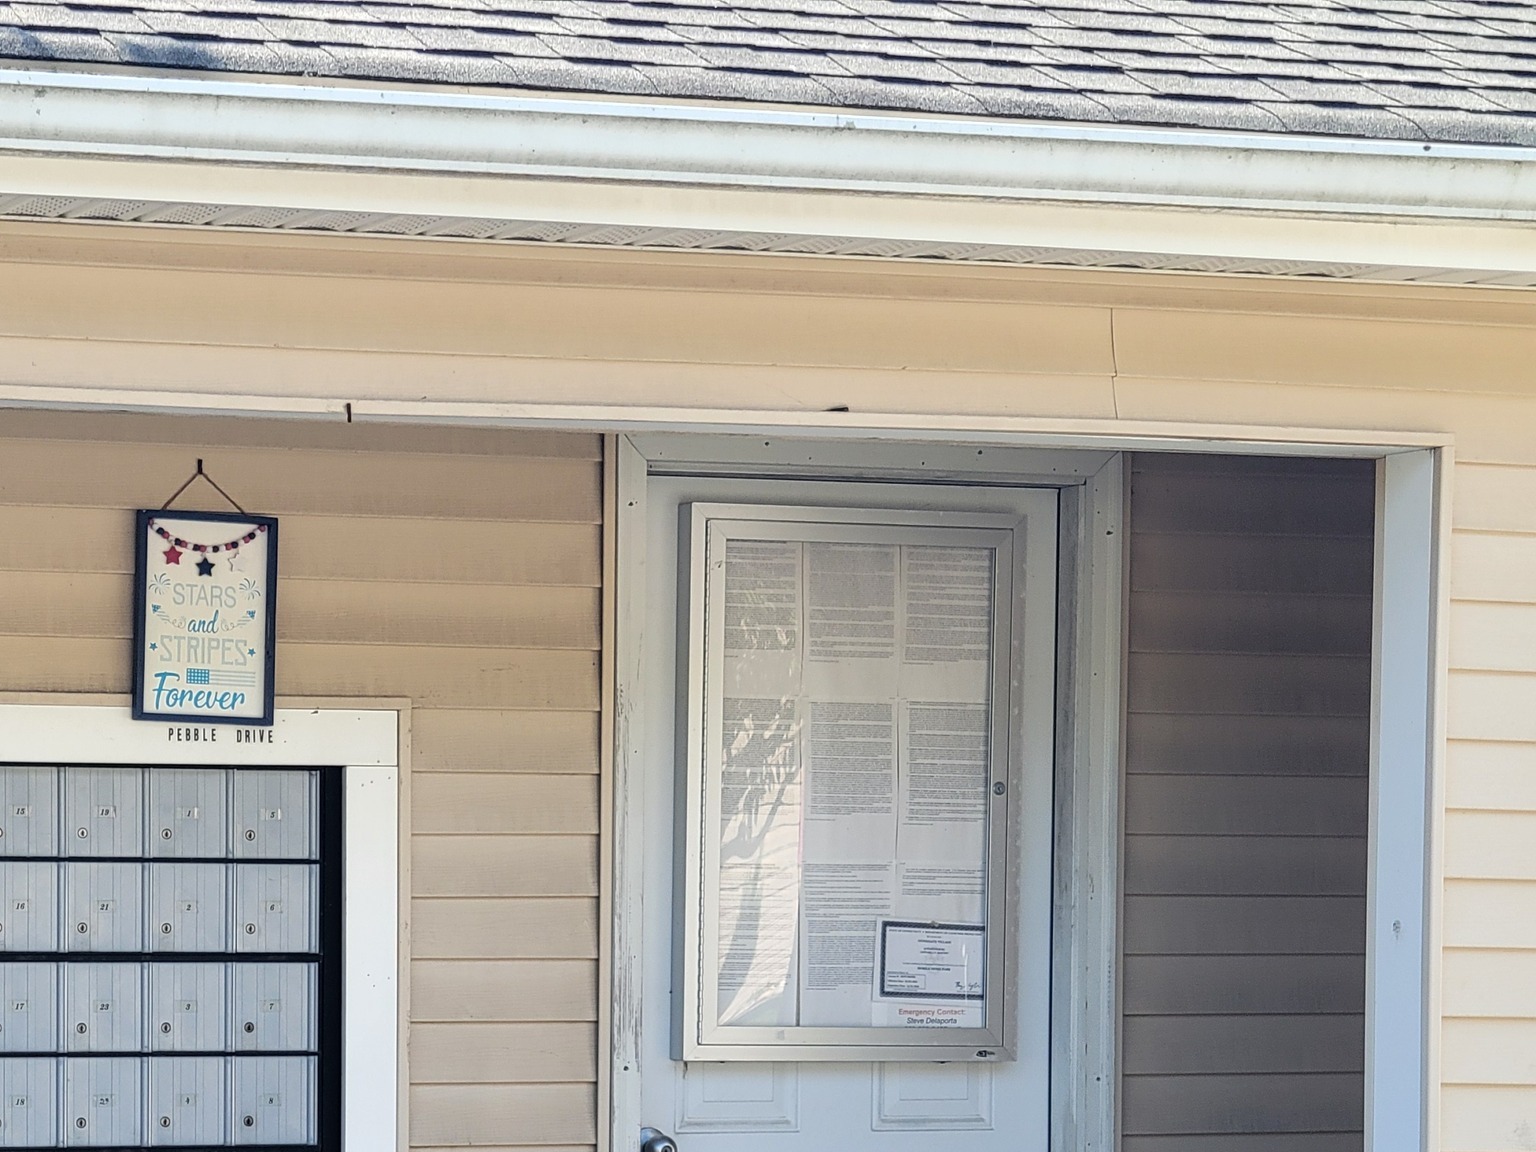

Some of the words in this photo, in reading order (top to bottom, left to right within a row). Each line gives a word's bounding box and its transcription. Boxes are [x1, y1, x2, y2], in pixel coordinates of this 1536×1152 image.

[172, 583, 237, 608] STARS
[187, 609, 219, 634] and
[159, 635, 248, 666] STRIPES
[152, 671, 246, 711] Forever
[168, 727, 218, 743] PEBBLE
[236, 728, 275, 744] DRIVE
[15, 807, 26, 815] 15
[100, 808, 110, 816] 19
[270, 811, 275, 819] 5
[15, 902, 25, 910] 16
[99, 903, 109, 911] 21
[14, 1003, 25, 1011] 17
[99, 1003, 110, 1011] 23
[185, 1003, 191, 1011] 3
[898, 1008, 936, 1017] Emergency
[925, 1017, 957, 1026] Delaporta
[15, 1098, 25, 1106] 18
[185, 1097, 190, 1105] 4
[268, 1097, 274, 1105] 8
